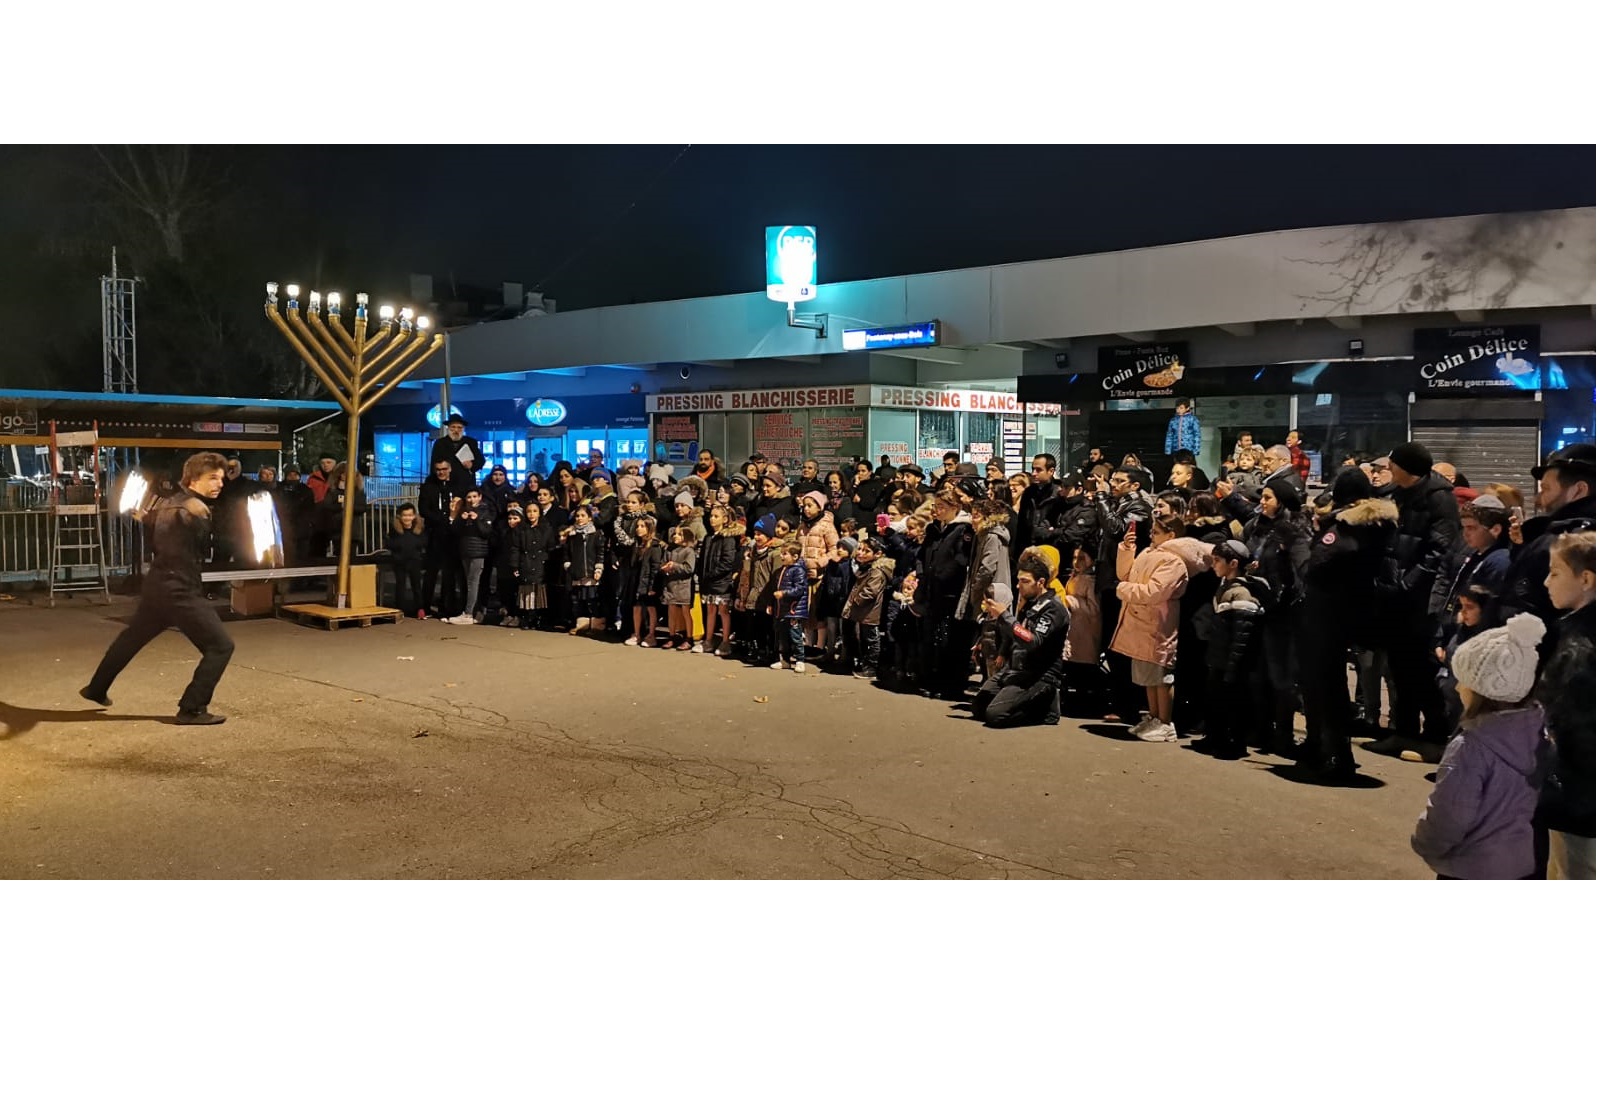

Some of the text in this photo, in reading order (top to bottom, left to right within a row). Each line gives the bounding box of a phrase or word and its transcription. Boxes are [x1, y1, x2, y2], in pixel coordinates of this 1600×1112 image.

[1420, 338, 1528, 379] Coin Délice
[1102, 354, 1179, 390] Coin Délice
[1428, 379, 1463, 388] L'Envie
[657, 388, 855, 410] PRESSING BLANCHISSERIE
[881, 388, 960, 408] PRESSING
[880, 443, 908, 452] PRESSING
